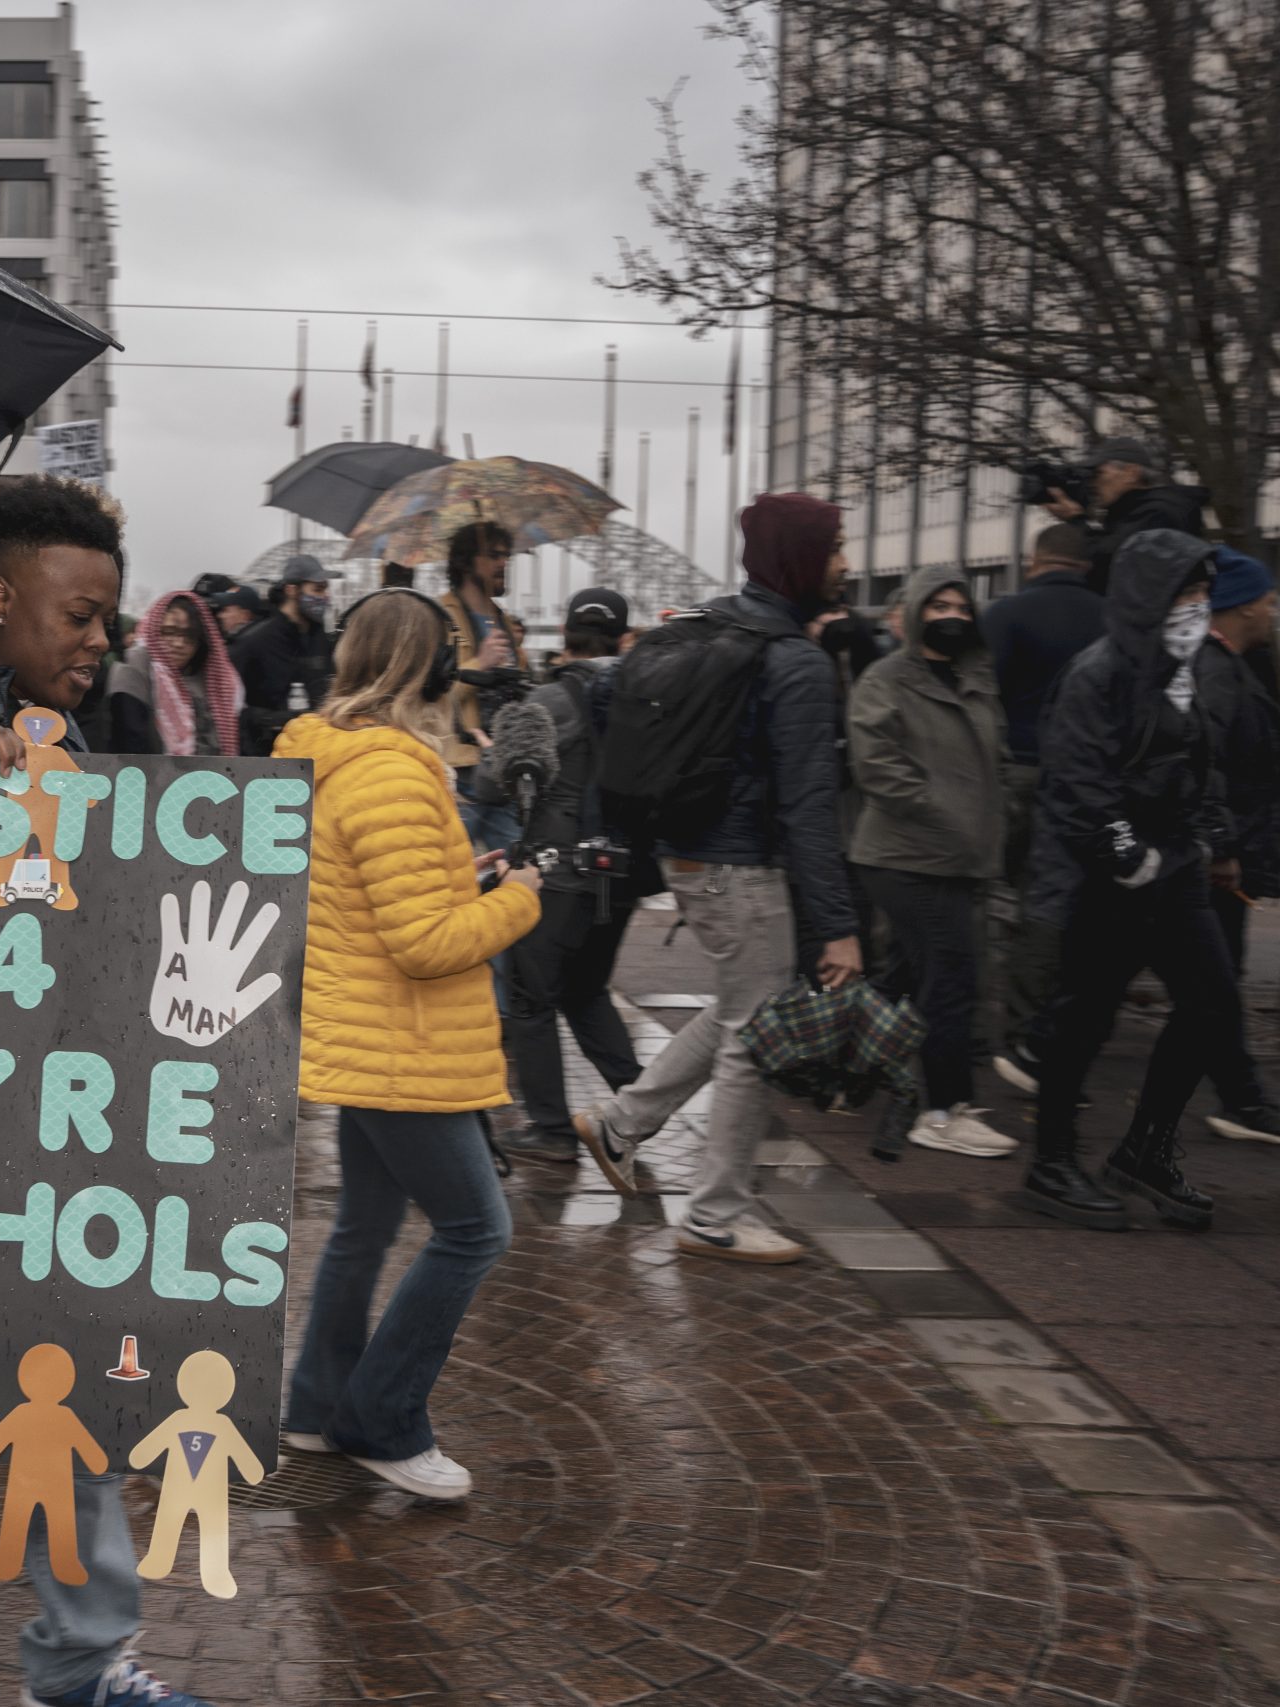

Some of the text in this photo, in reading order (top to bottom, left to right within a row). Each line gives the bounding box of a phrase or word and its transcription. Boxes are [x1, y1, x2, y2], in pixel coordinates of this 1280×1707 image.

[33, 719, 41, 730] 1
[164, 952, 187, 981] A
[165, 996, 236, 1035] MAN
[190, 1435, 202, 1452] 5
